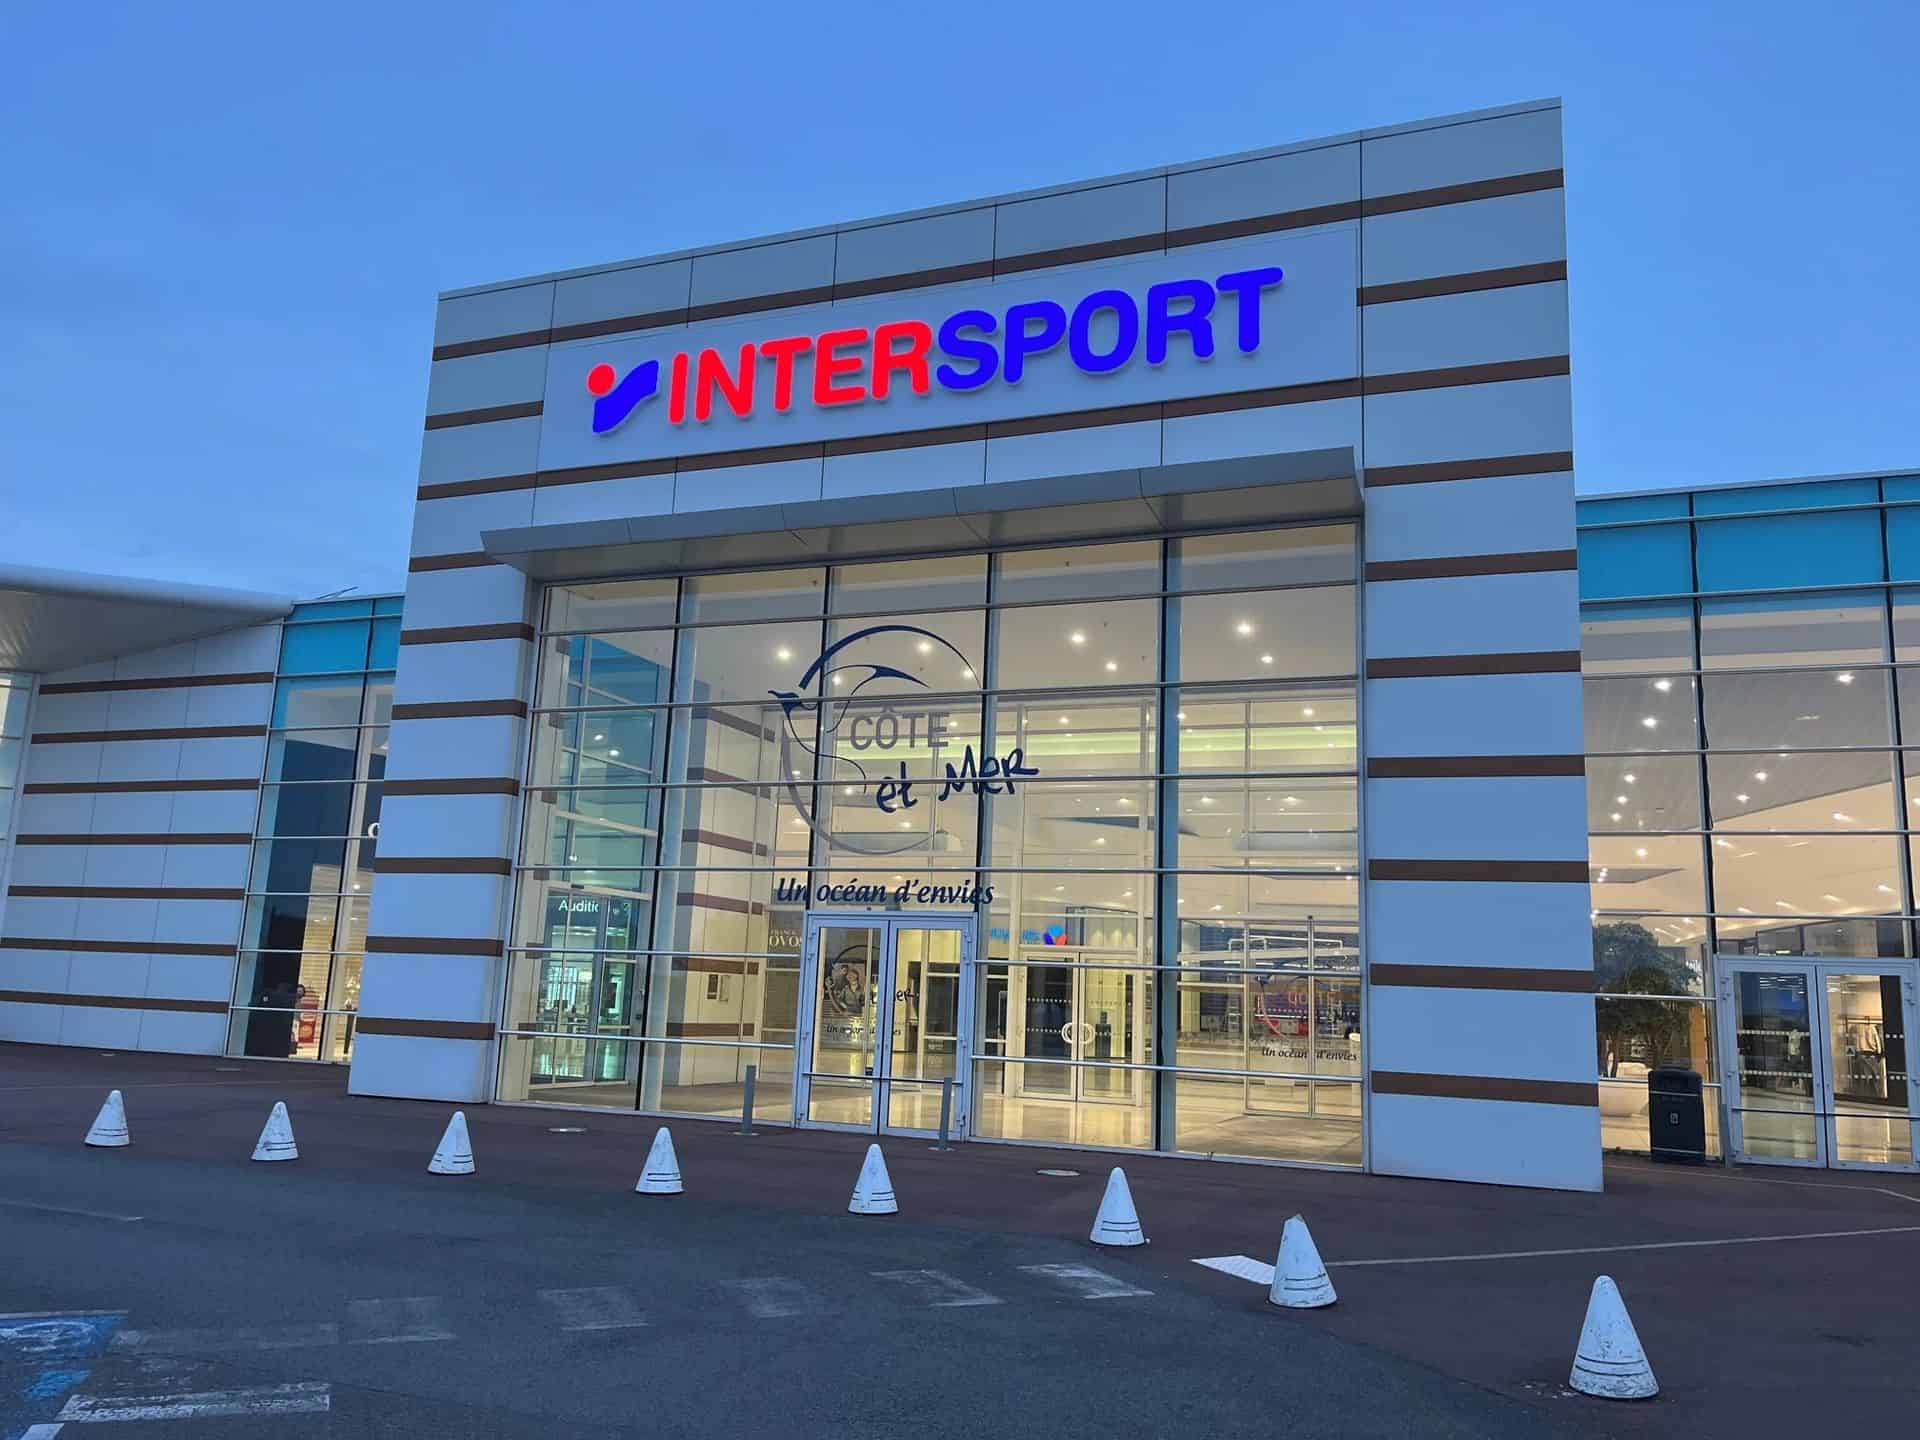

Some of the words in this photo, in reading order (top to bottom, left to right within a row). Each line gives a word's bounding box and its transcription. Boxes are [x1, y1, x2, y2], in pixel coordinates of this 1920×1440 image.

[668, 266, 1284, 426] INTERSPORT
[849, 703, 951, 750] CÔTE
[875, 760, 918, 813] et
[777, 877, 810, 903] Un
[816, 877, 887, 902] océan
[892, 879, 995, 905] d'envies
